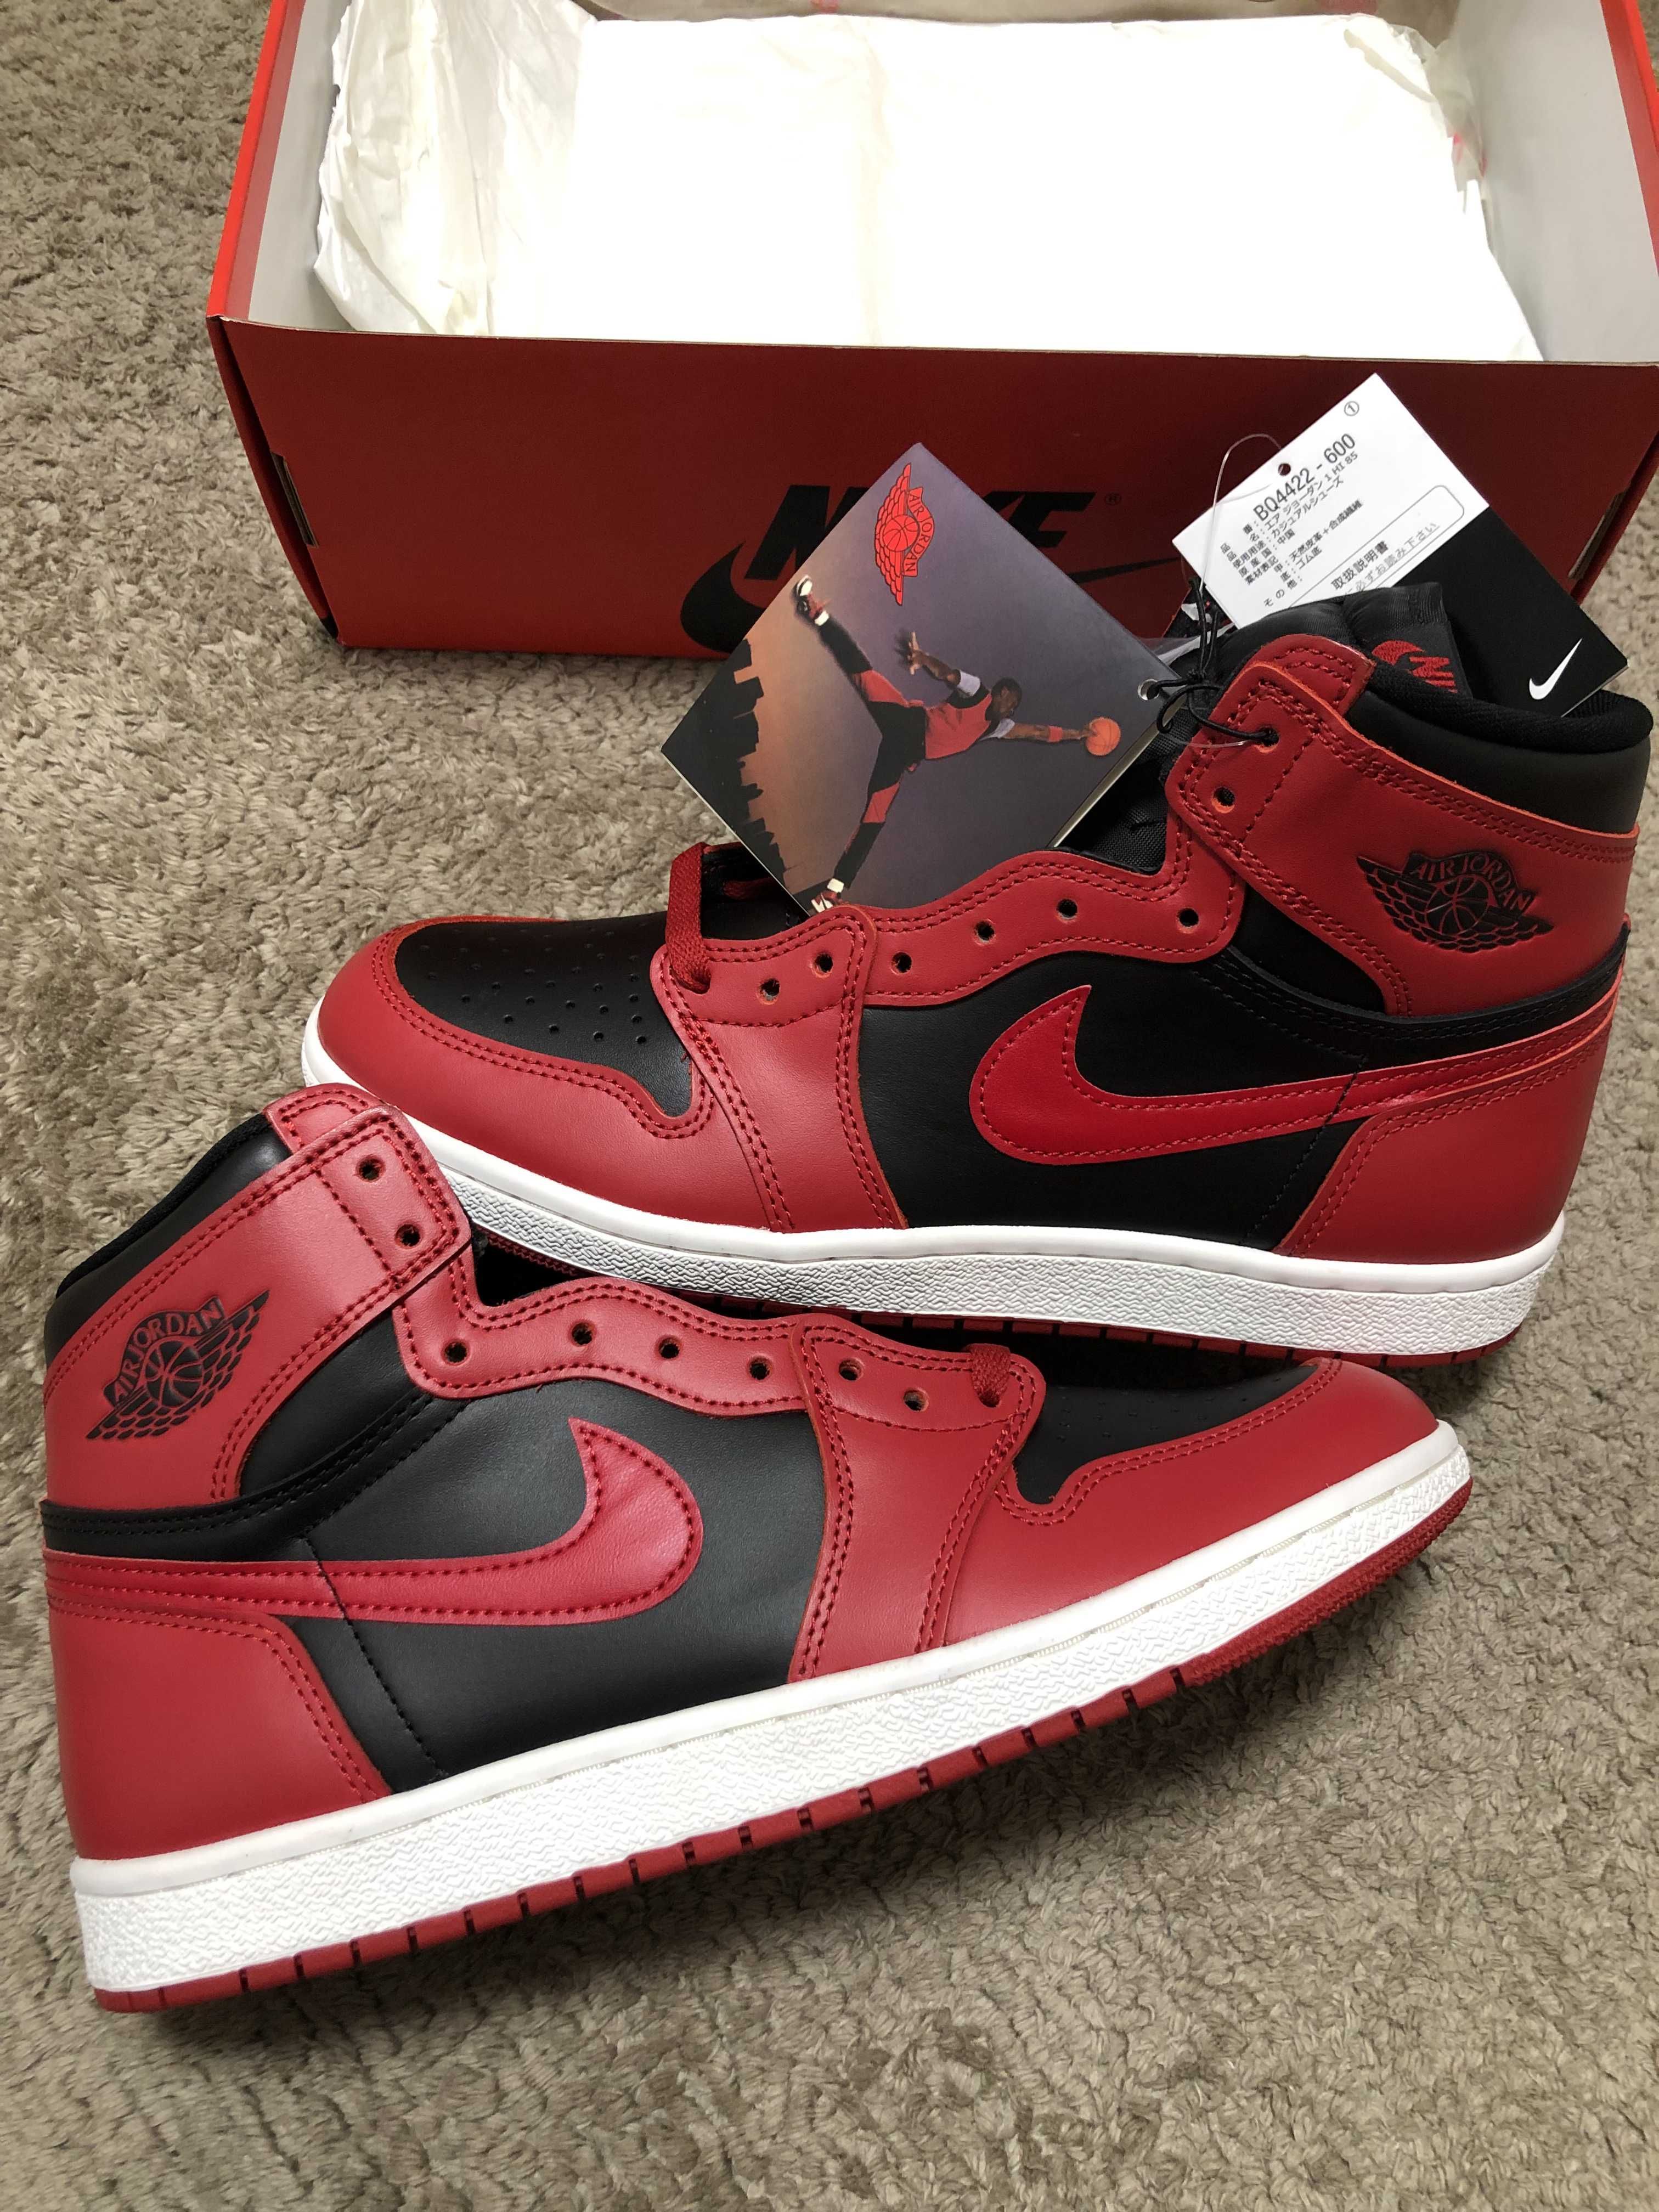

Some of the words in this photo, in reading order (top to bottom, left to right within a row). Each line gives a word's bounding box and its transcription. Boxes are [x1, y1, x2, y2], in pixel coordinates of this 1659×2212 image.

[909, 494, 925, 518] AIR
[1253, 468, 1315, 521] BQ4422
[1324, 434, 1355, 464] 600
[1265, 513, 1279, 531] エア
[1332, 461, 1345, 476] HI
[1345, 452, 1358, 464] 85
[905, 516, 933, 573] JORDAN
[1277, 528, 1295, 544] 中国
[1331, 541, 1388, 590] 取扱説明書
[1412, 861, 1455, 881] AIR
[1462, 853, 1532, 911] JORDAN
[114, 1358, 140, 1403] AIR
[128, 1300, 223, 1359] JORDAN
